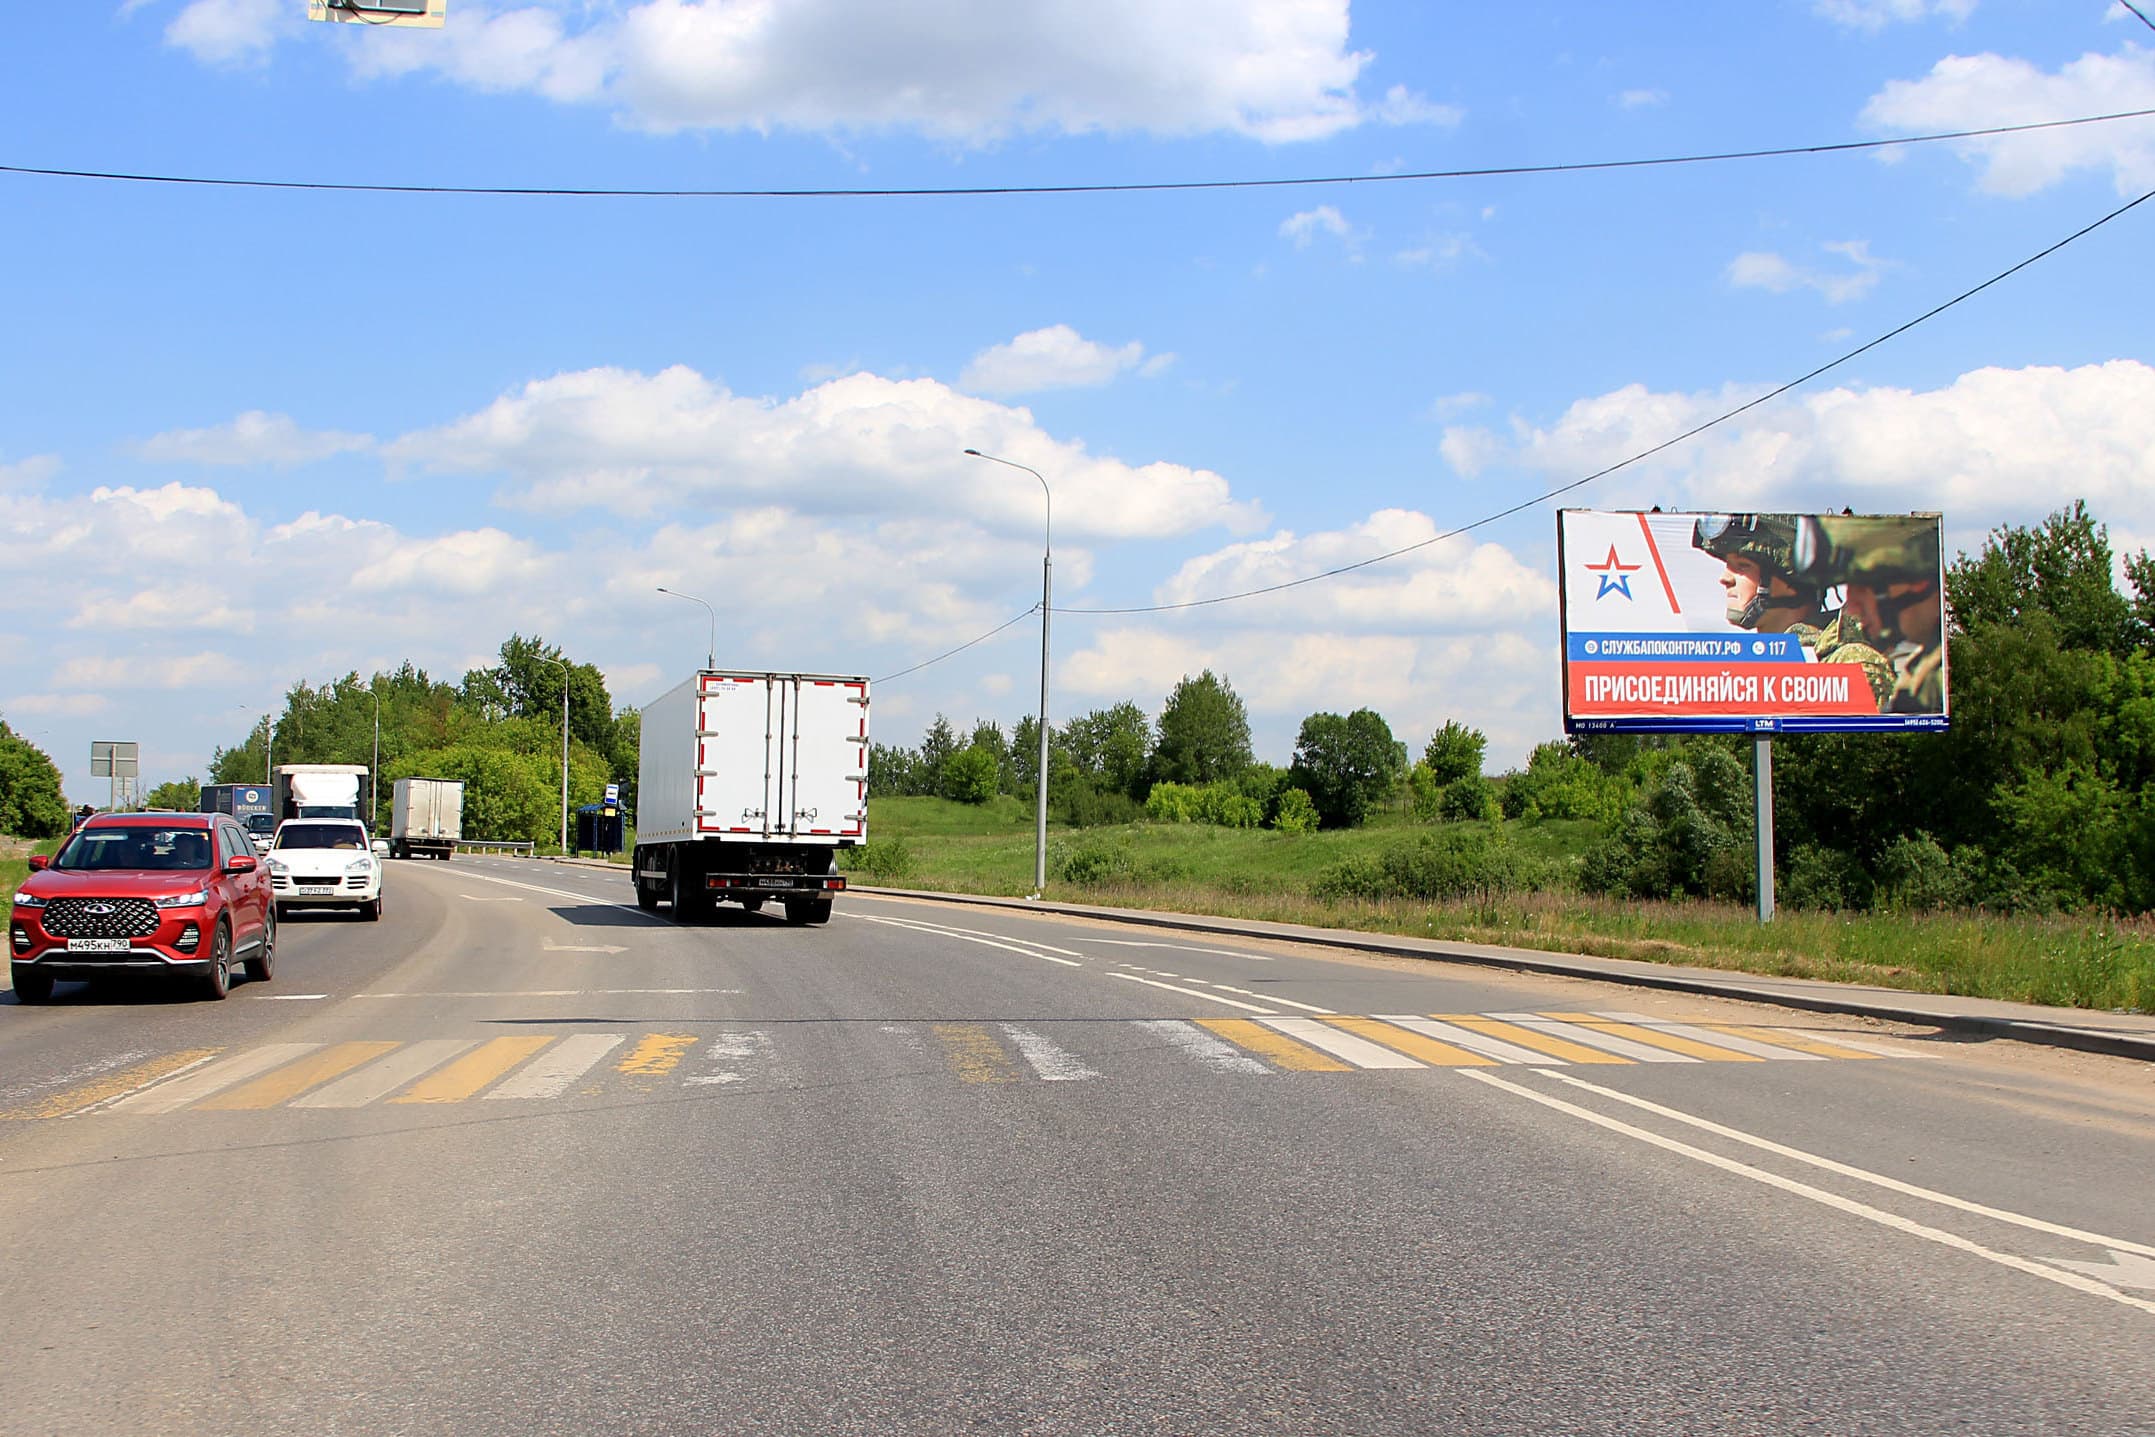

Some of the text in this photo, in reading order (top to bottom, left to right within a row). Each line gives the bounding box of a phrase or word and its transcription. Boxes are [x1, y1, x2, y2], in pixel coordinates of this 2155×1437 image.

[1601, 640, 1786, 656] СЛУЖБАПОКОНТРАКТУ.РФ 117
[1585, 671, 1848, 704] ПРИСОЕДИНЯЙСЯ К СВОИМ
[1755, 719, 1774, 727] LTM
[112, 939, 128, 947] 790
